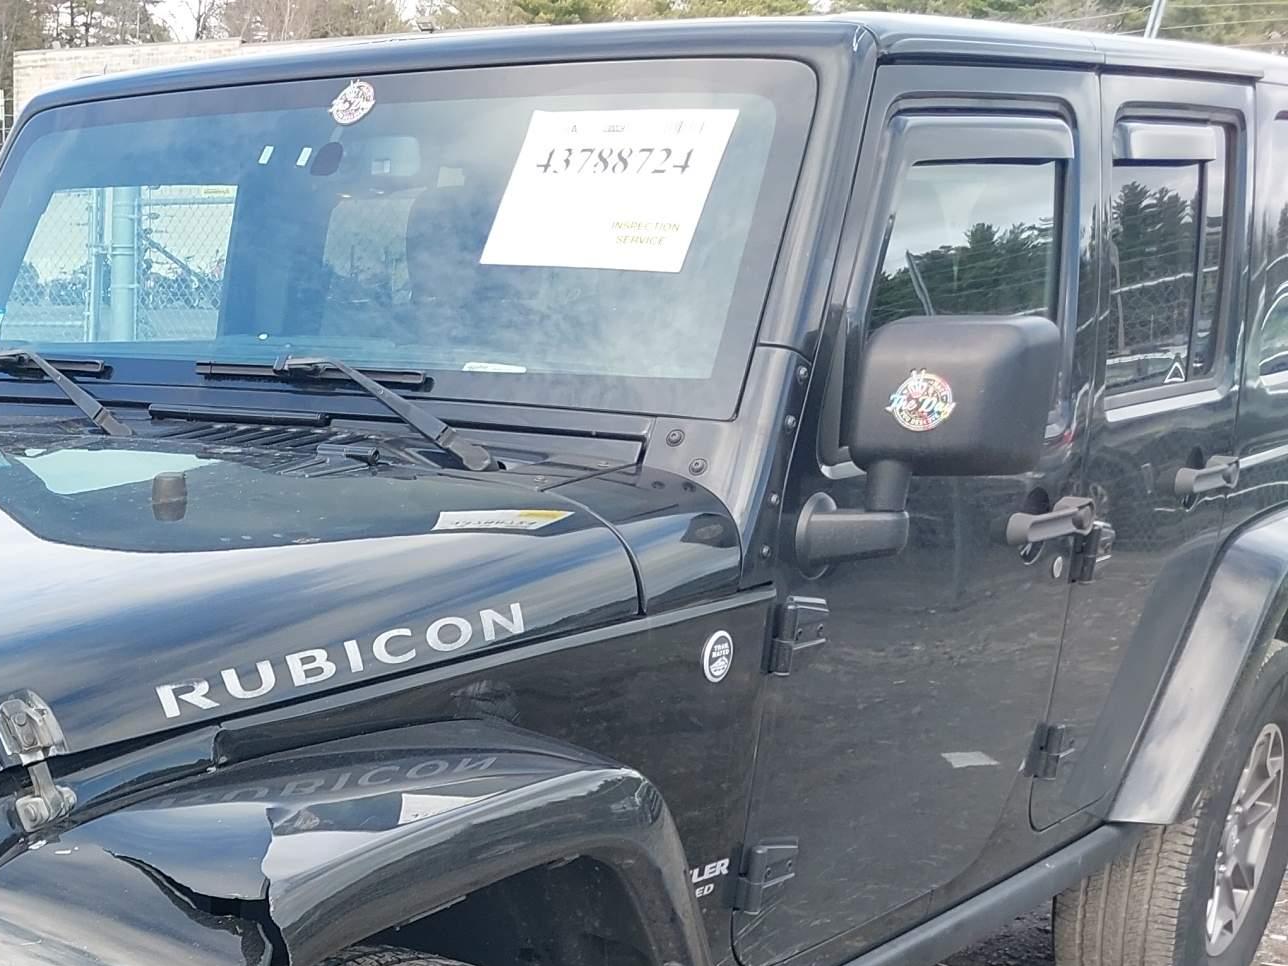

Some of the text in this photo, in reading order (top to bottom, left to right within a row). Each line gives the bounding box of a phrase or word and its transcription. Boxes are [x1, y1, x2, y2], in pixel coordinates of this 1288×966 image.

[536, 148, 695, 174] 43788724
[611, 220, 681, 233] INSPECTION
[614, 234, 668, 246] SERVICE
[155, 602, 525, 719] RUBICON
[689, 858, 730, 884] LER
